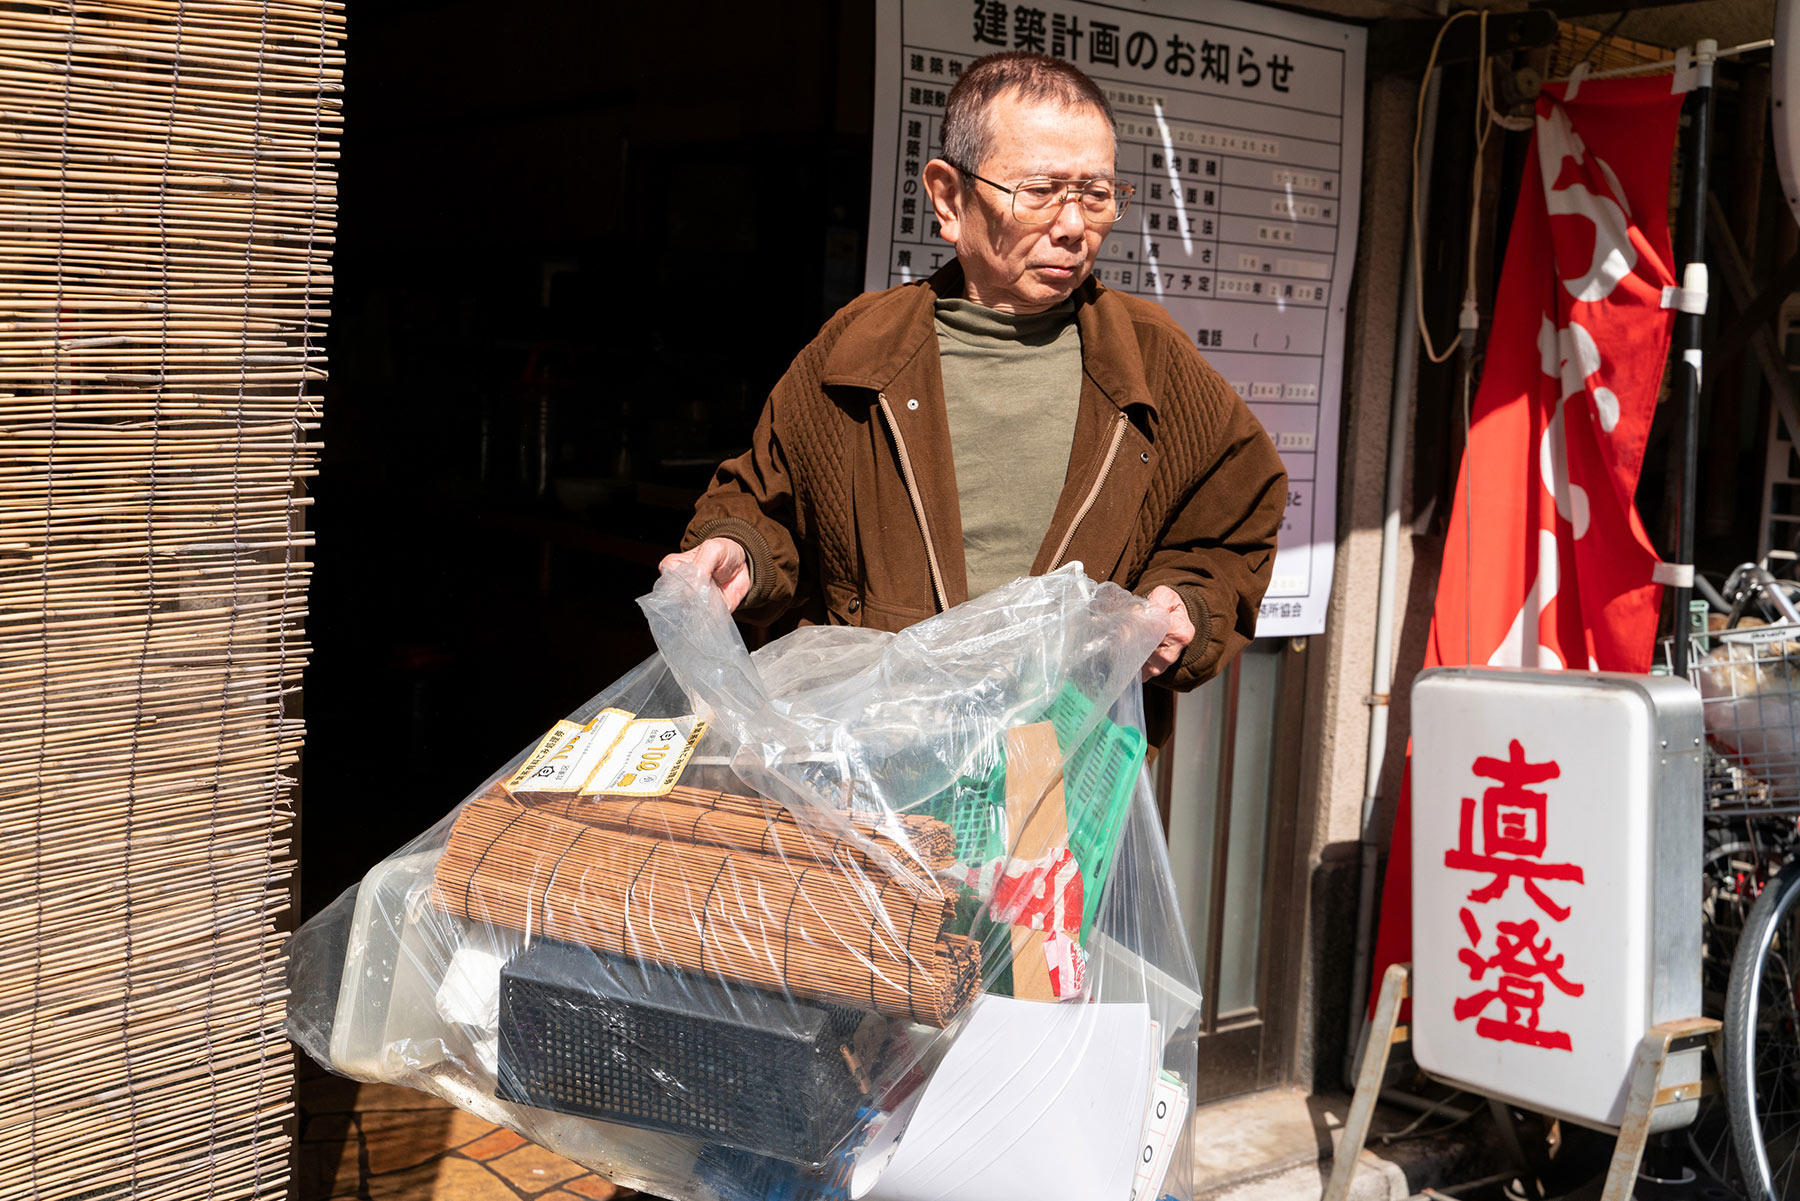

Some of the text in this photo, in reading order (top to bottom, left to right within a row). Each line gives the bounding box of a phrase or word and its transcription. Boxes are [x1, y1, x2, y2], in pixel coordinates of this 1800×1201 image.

[973, 0, 1294, 93] 建築計画のお知らせ
[899, 119, 921, 236] 建築物の概要
